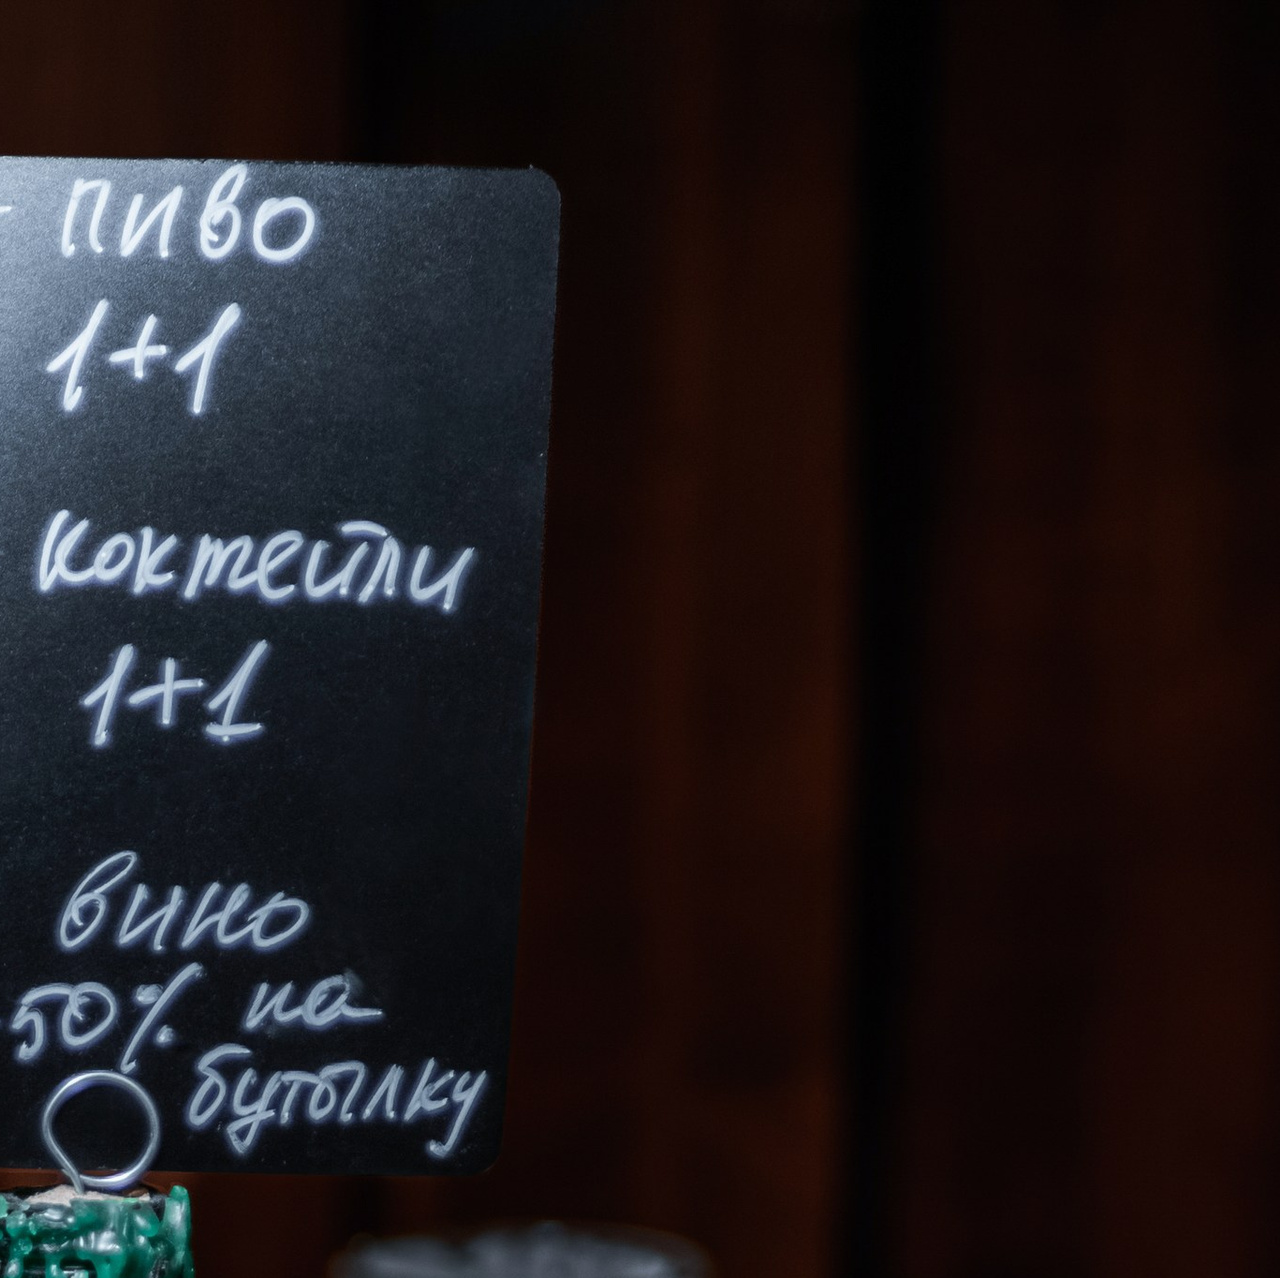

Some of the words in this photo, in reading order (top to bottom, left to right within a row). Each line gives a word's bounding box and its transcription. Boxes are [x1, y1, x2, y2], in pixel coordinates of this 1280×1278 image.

[61, 163, 316, 263] пиво
[45, 298, 242, 414] 1+1
[80, 638, 270, 747] 1+1
[59, 850, 311, 951] вино
[187, 1043, 487, 1161] бутылку
